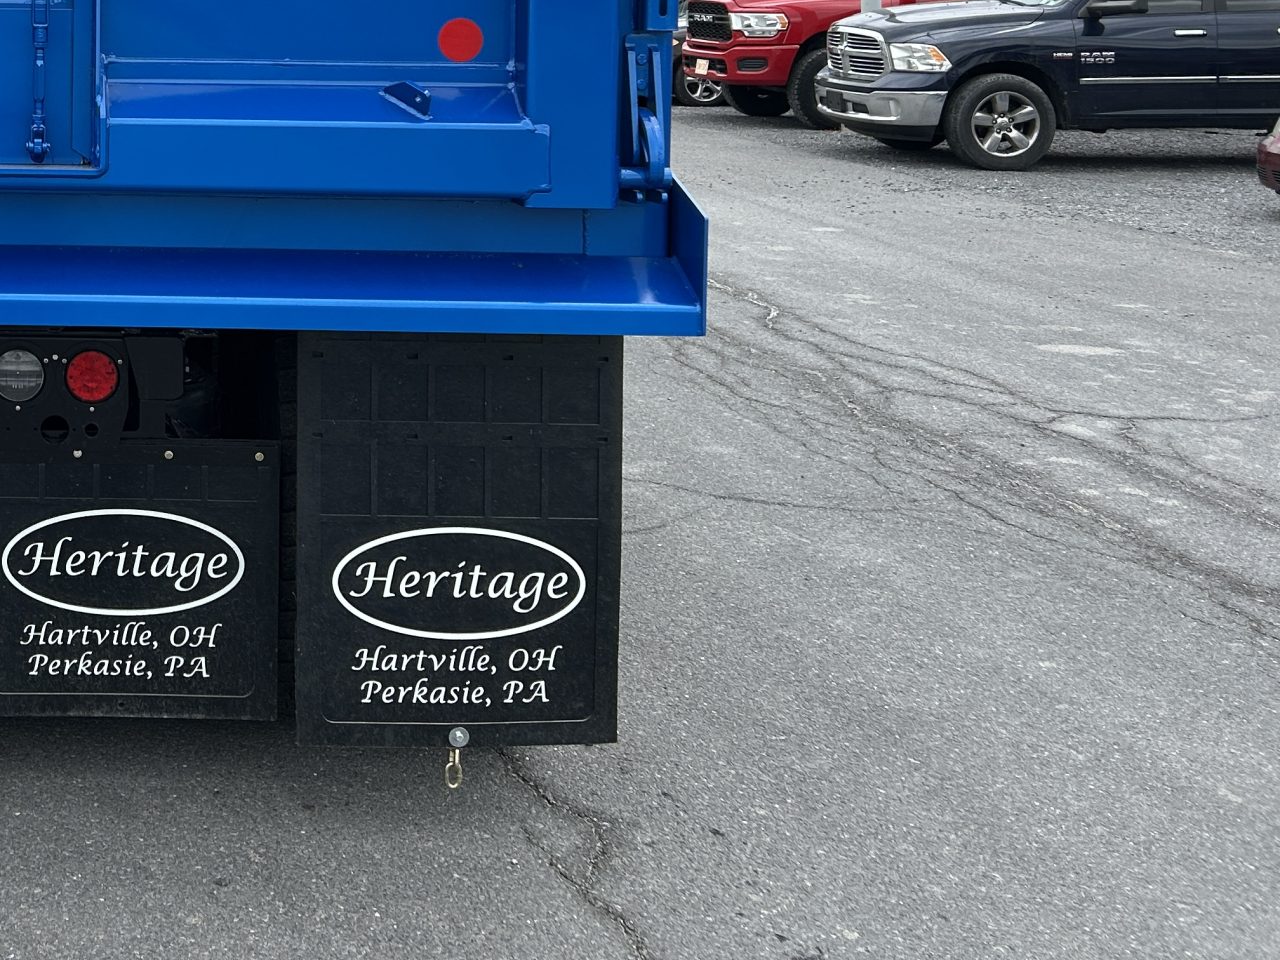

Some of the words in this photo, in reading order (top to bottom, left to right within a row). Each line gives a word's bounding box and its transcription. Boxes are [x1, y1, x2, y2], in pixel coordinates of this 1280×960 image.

[694, 14, 713, 22] RAM
[17, 536, 228, 592] Heritage
[349, 556, 569, 614] Heritage
[20, 620, 158, 649] Hartville,
[169, 623, 222, 648] OH
[28, 652, 153, 680] Perkasie,
[164, 656, 210, 678] PA
[351, 645, 497, 675] Hartville,
[508, 645, 563, 671] OH
[360, 677, 492, 707] Perkasie,
[502, 680, 550, 704] PA
